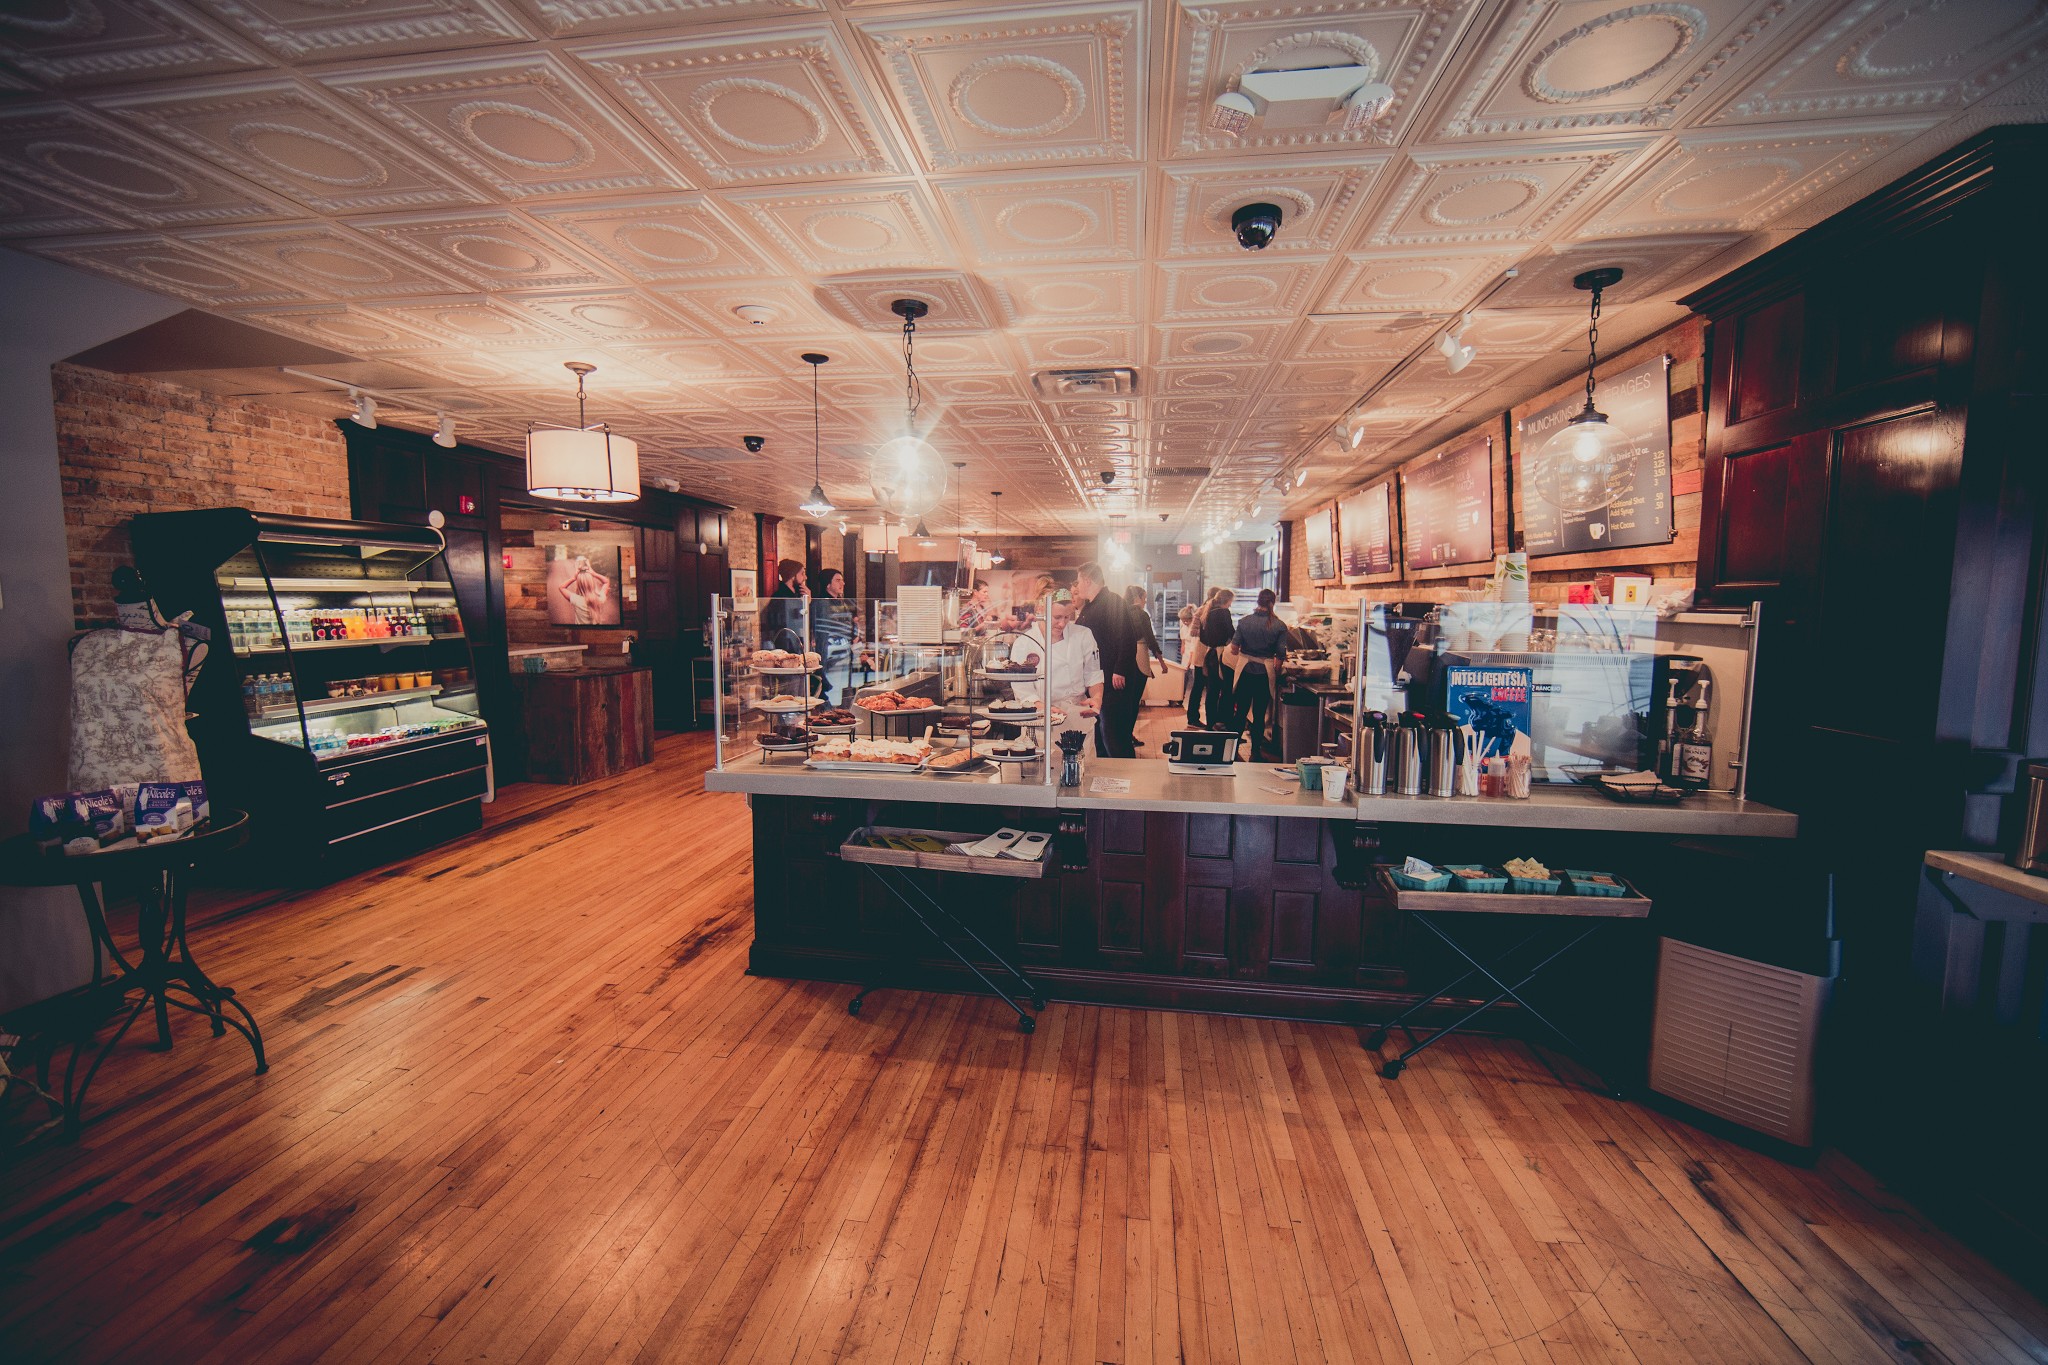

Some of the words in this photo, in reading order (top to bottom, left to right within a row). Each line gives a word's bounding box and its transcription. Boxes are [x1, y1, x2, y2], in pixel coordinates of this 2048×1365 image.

[1527, 405, 1572, 436] MUNCHKINS
[1590, 372, 1651, 405] EVERAGES
[1451, 671, 1528, 687] INTELLIGENTSIA
[1491, 686, 1527, 703] COFFEE
[148, 787, 176, 799] Nicole's
[186, 785, 203, 796] ole's
[83, 795, 114, 809] Nicole's
